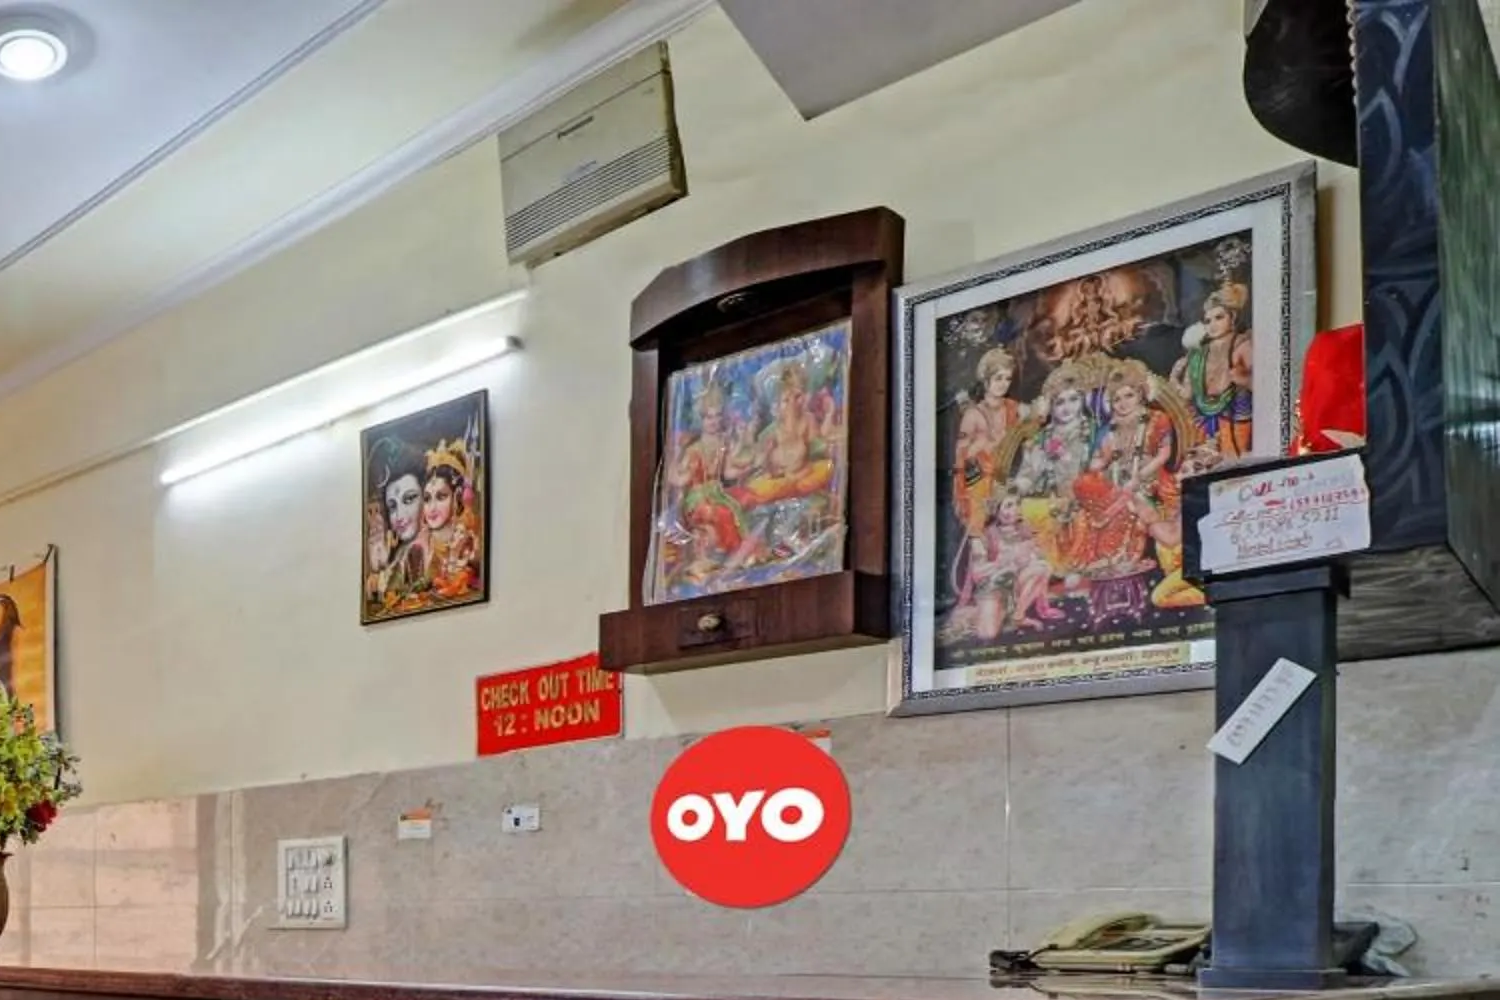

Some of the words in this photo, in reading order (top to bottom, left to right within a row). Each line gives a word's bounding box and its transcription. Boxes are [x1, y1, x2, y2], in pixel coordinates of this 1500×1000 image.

[481, 679, 530, 711] CHECK
[537, 669, 570, 702] OUT
[576, 666, 615, 695] TIME
[534, 697, 601, 731] NOON
[667, 787, 824, 842] OYO
